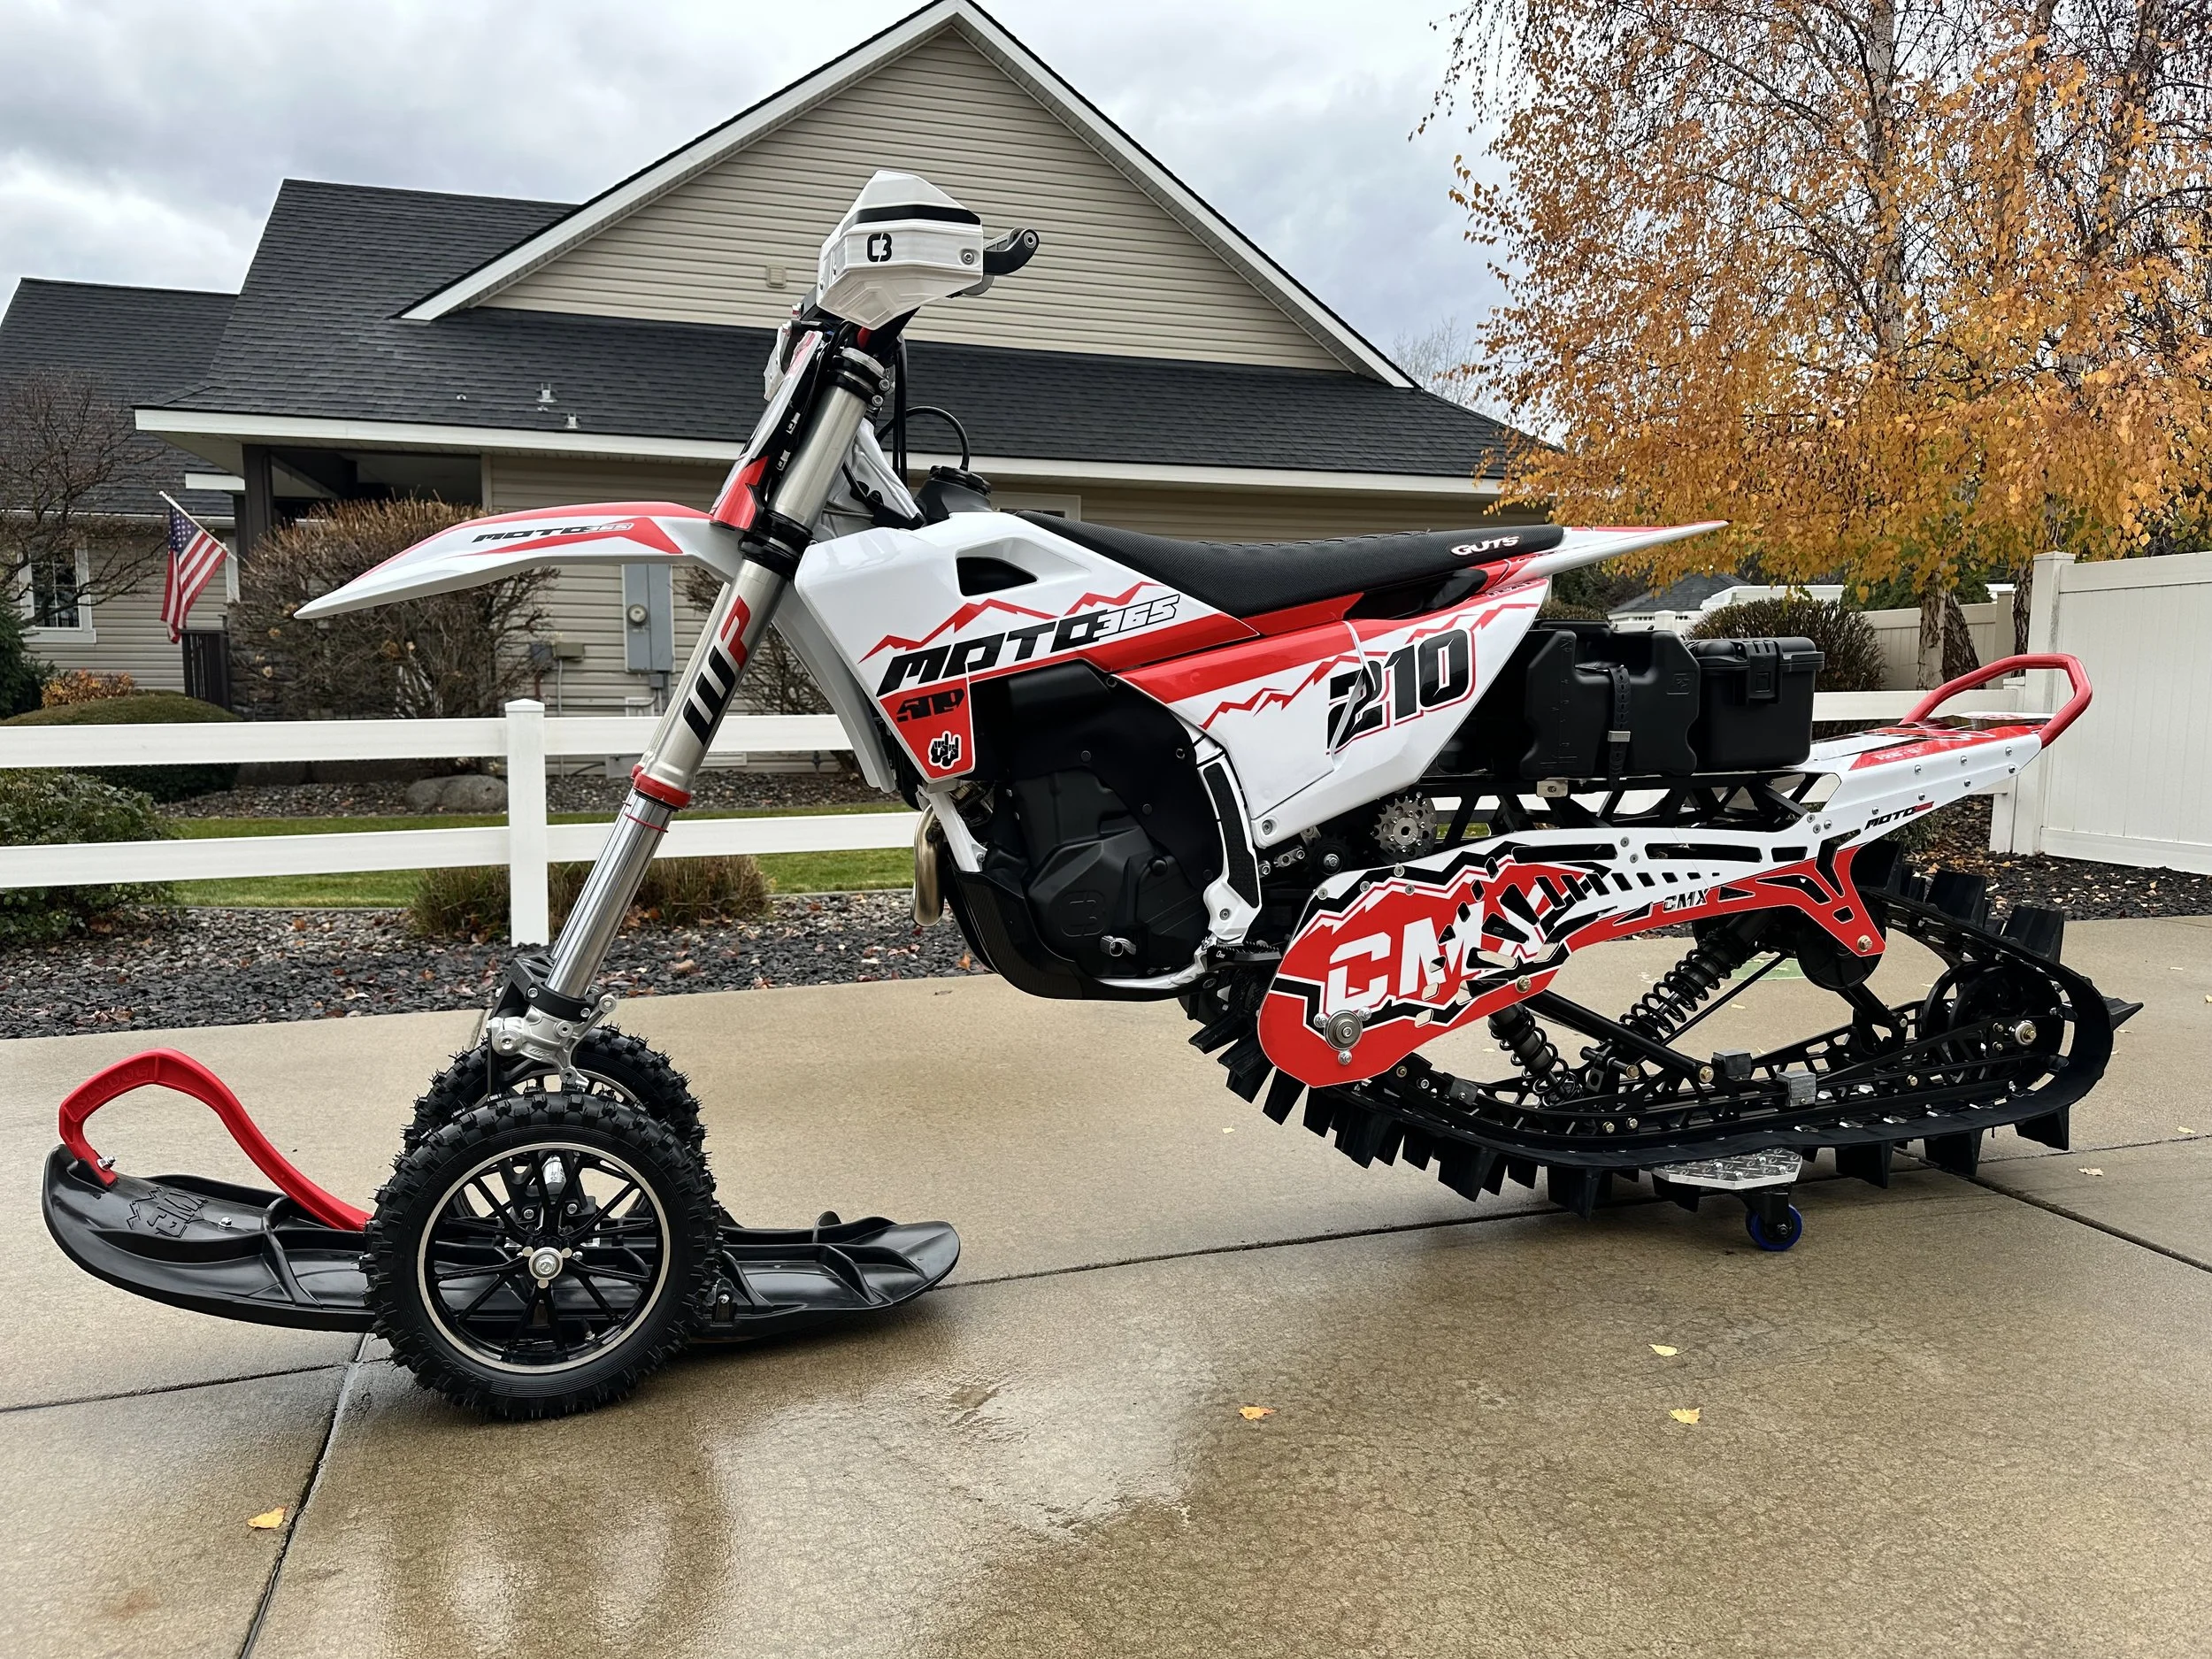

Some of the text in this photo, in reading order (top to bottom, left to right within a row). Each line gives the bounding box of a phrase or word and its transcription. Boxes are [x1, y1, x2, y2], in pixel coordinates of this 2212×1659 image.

[867, 233, 893, 263] C3
[1450, 535, 1520, 557] GUTS
[682, 595, 751, 748] WP
[876, 595, 1180, 698] MOTO365
[1326, 628, 1474, 752] 210
[1663, 887, 1709, 911] CMX
[1326, 885, 1548, 1019] CMX
